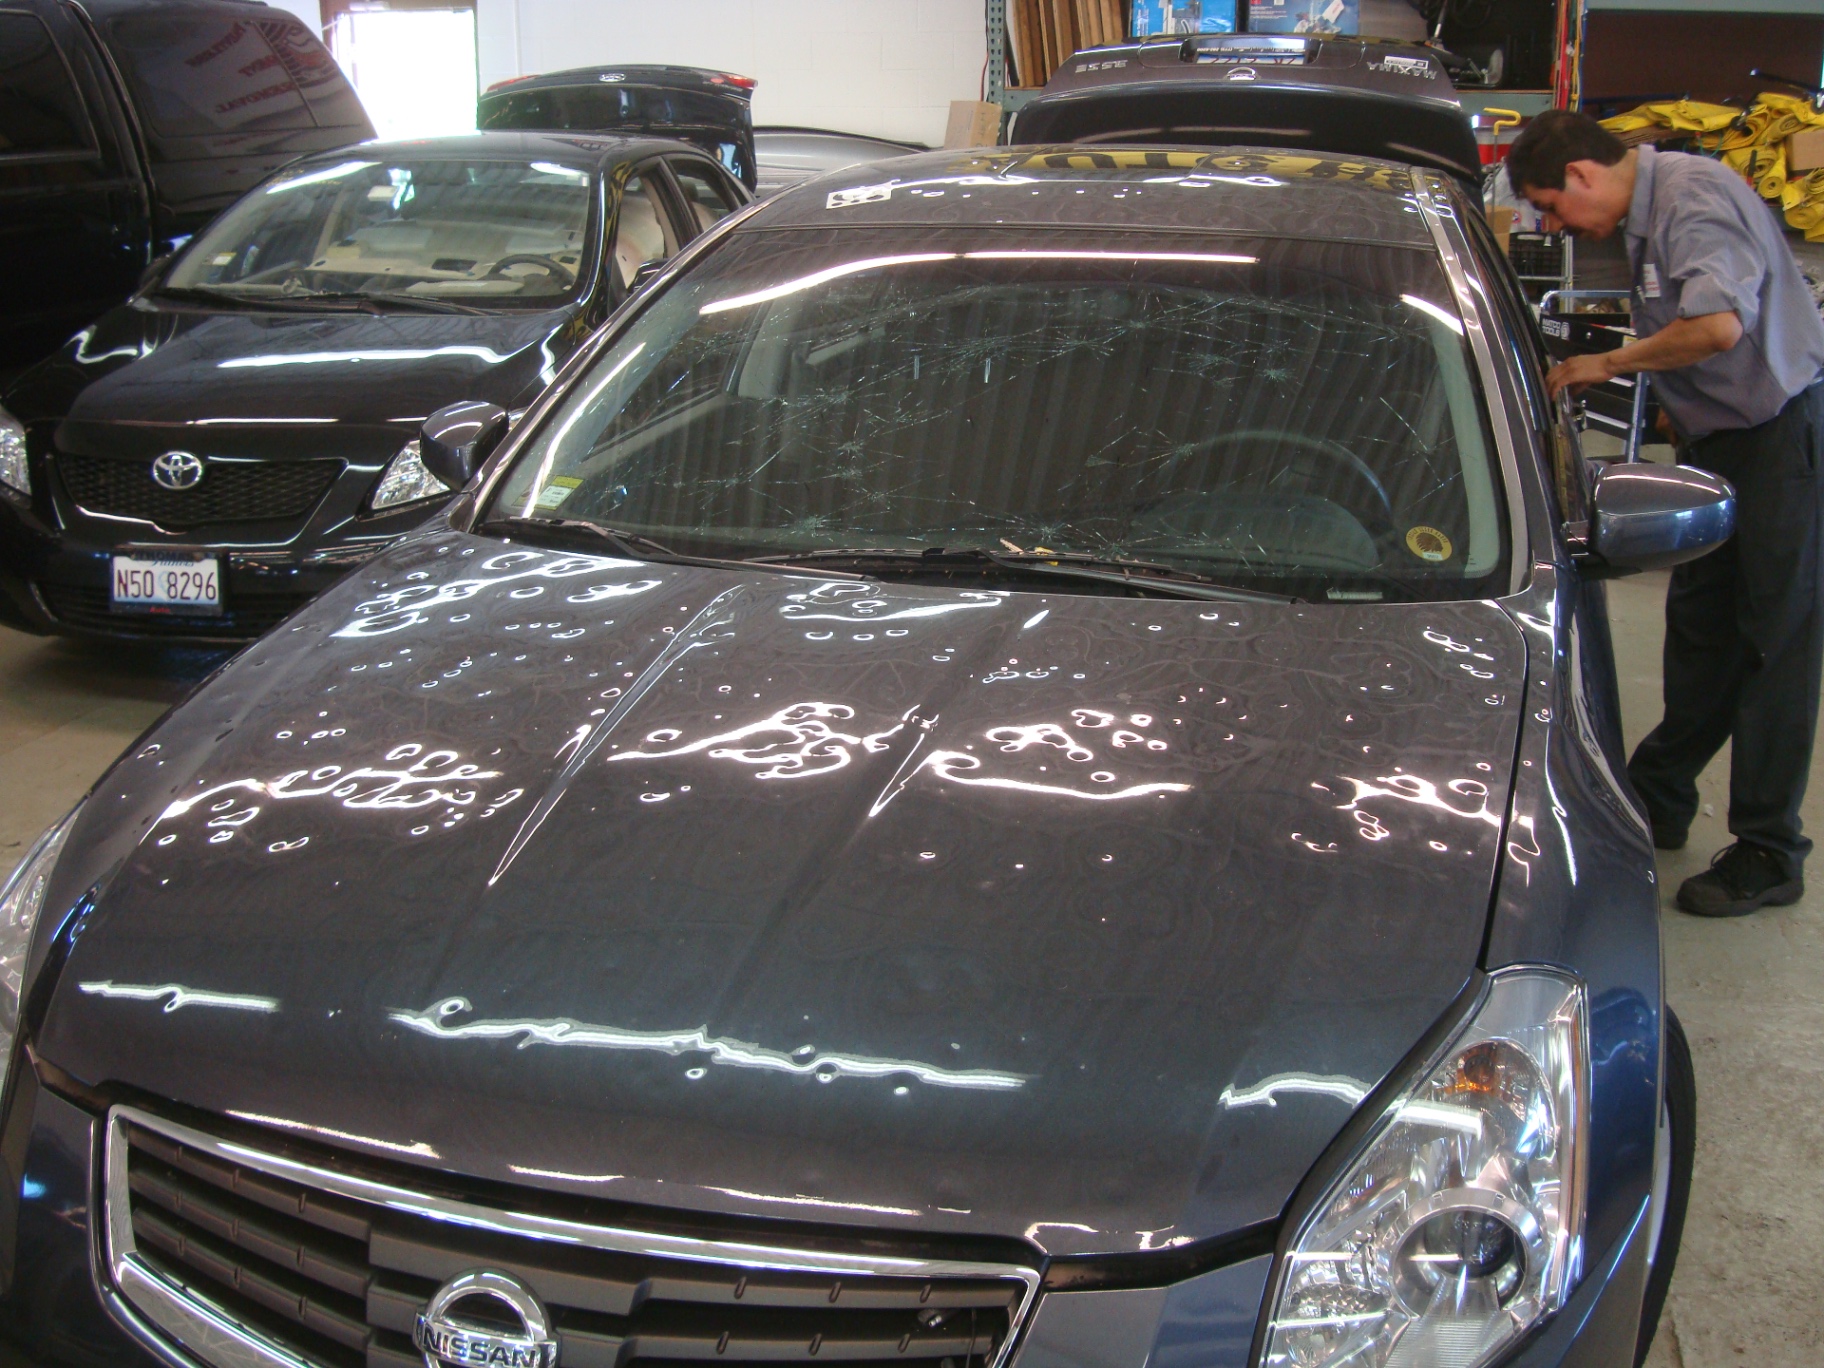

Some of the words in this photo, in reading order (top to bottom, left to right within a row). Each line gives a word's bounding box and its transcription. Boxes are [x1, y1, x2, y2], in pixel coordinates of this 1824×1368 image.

[1366, 61, 1438, 80] MAXIMA
[1542, 326, 1560, 337] TOOLS
[117, 569, 155, 598] N50
[166, 571, 217, 601] 8296
[424, 1321, 536, 1367] NISSAN
